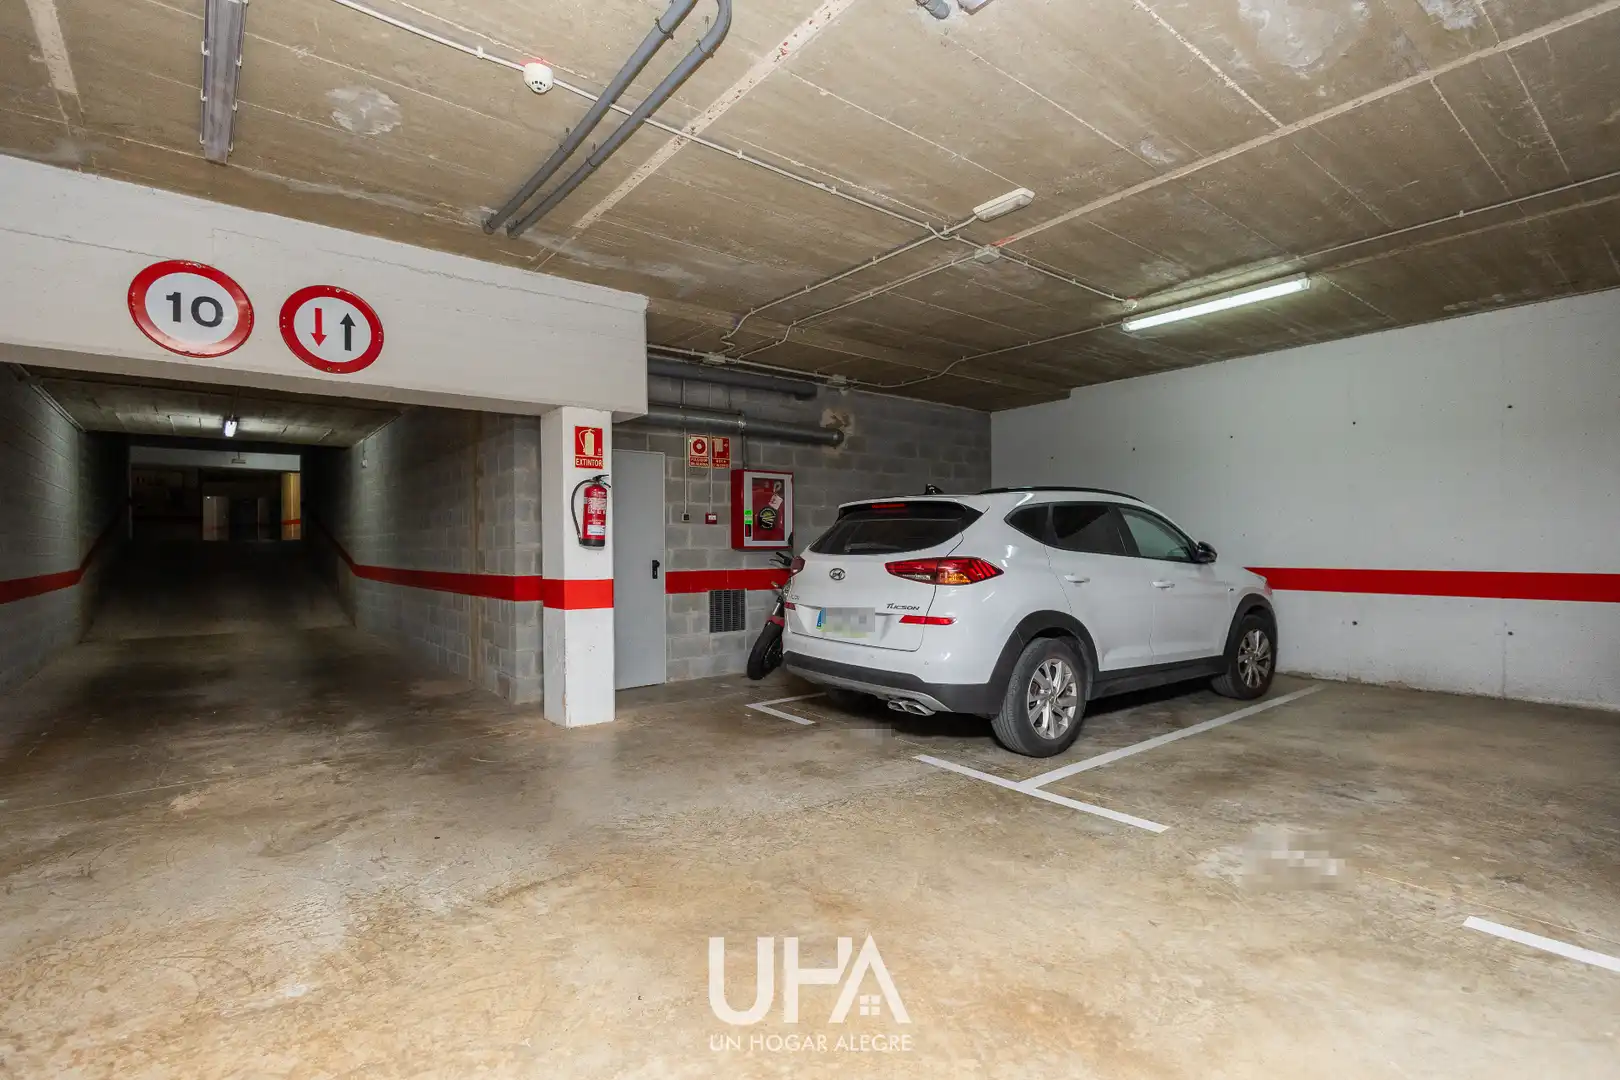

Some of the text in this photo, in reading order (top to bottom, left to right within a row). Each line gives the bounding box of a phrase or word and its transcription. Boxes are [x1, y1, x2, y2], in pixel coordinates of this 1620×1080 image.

[166, 292, 224, 328] 10
[575, 458, 602, 467] EXTINTOR
[886, 602, 920, 611] TUCSON
